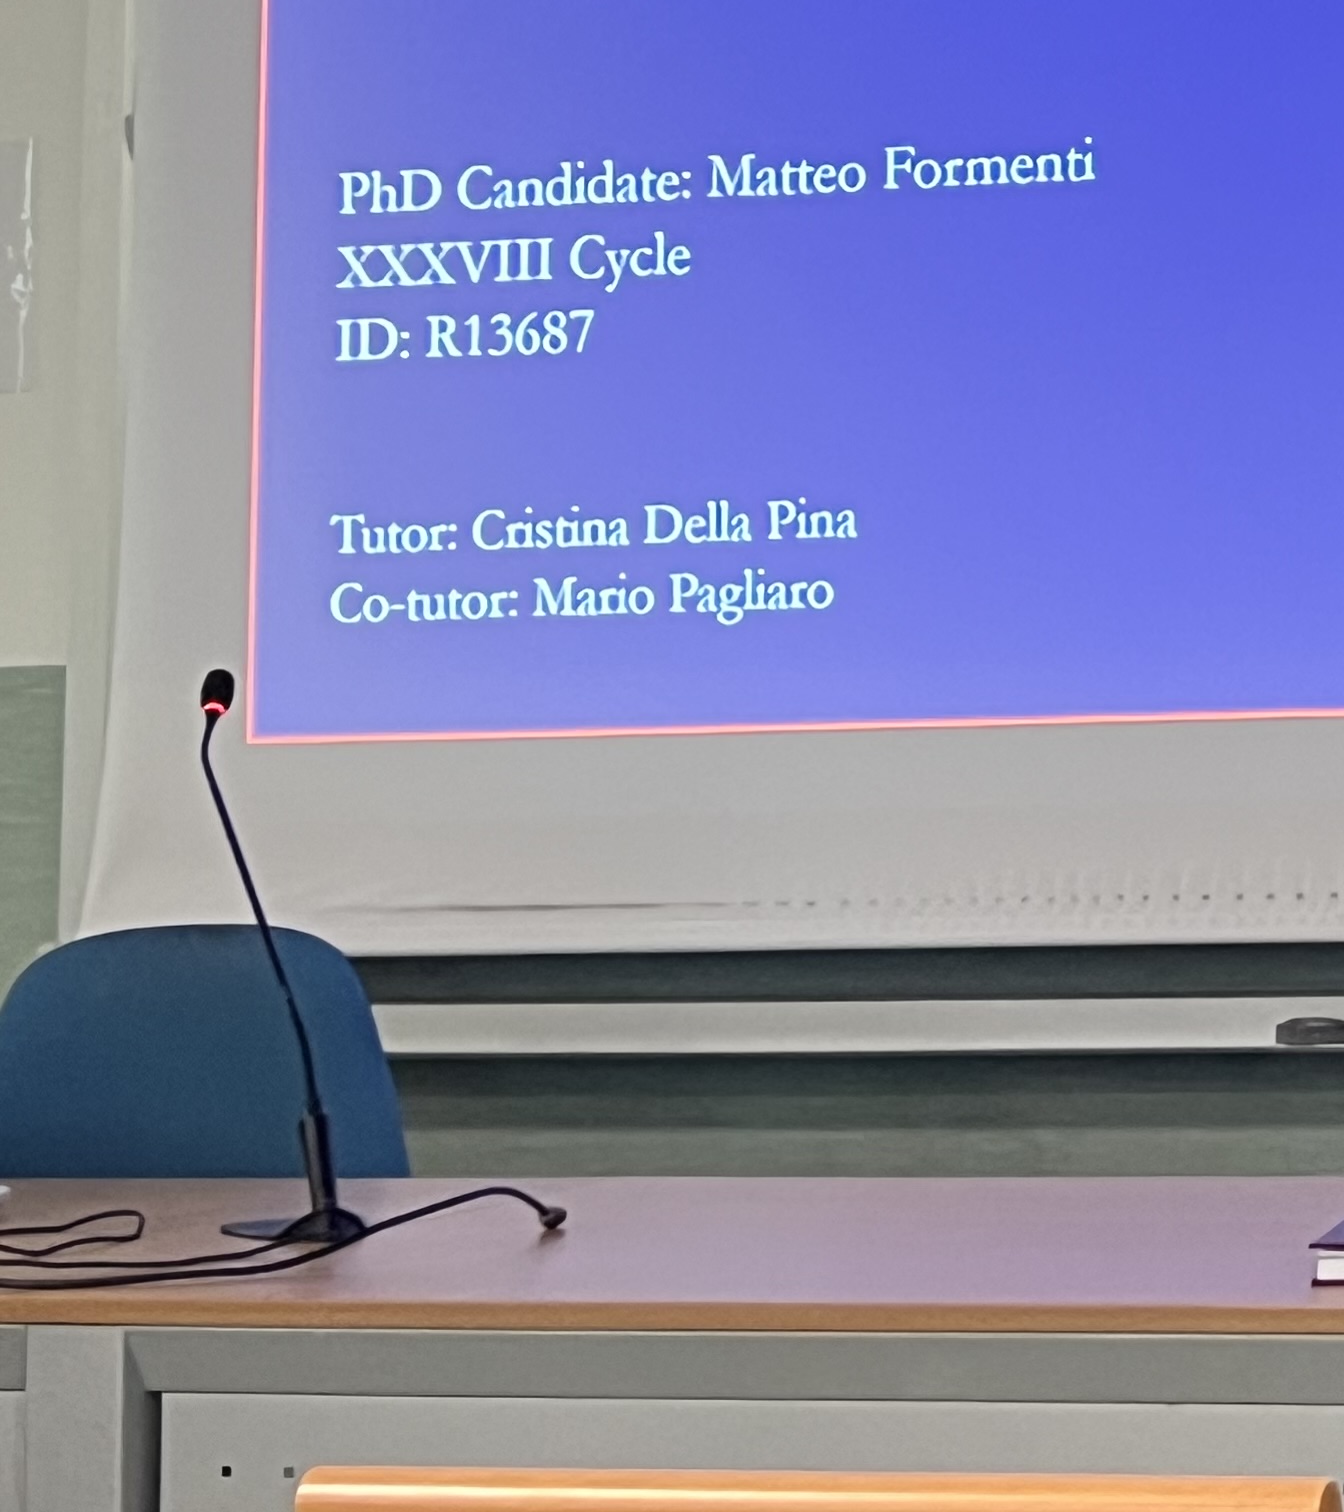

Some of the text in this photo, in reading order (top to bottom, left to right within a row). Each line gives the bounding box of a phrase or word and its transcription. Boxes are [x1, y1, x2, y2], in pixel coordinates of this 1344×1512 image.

[339, 137, 1095, 214] PhD Candidate: Matteo Formenti
[336, 231, 691, 293] XXXVIII Cycle
[335, 309, 594, 362] ID: R13687
[329, 497, 858, 554] Tutor: Cristina Della Pina
[330, 568, 834, 626] Co-tutor: Mario Pagliaro
